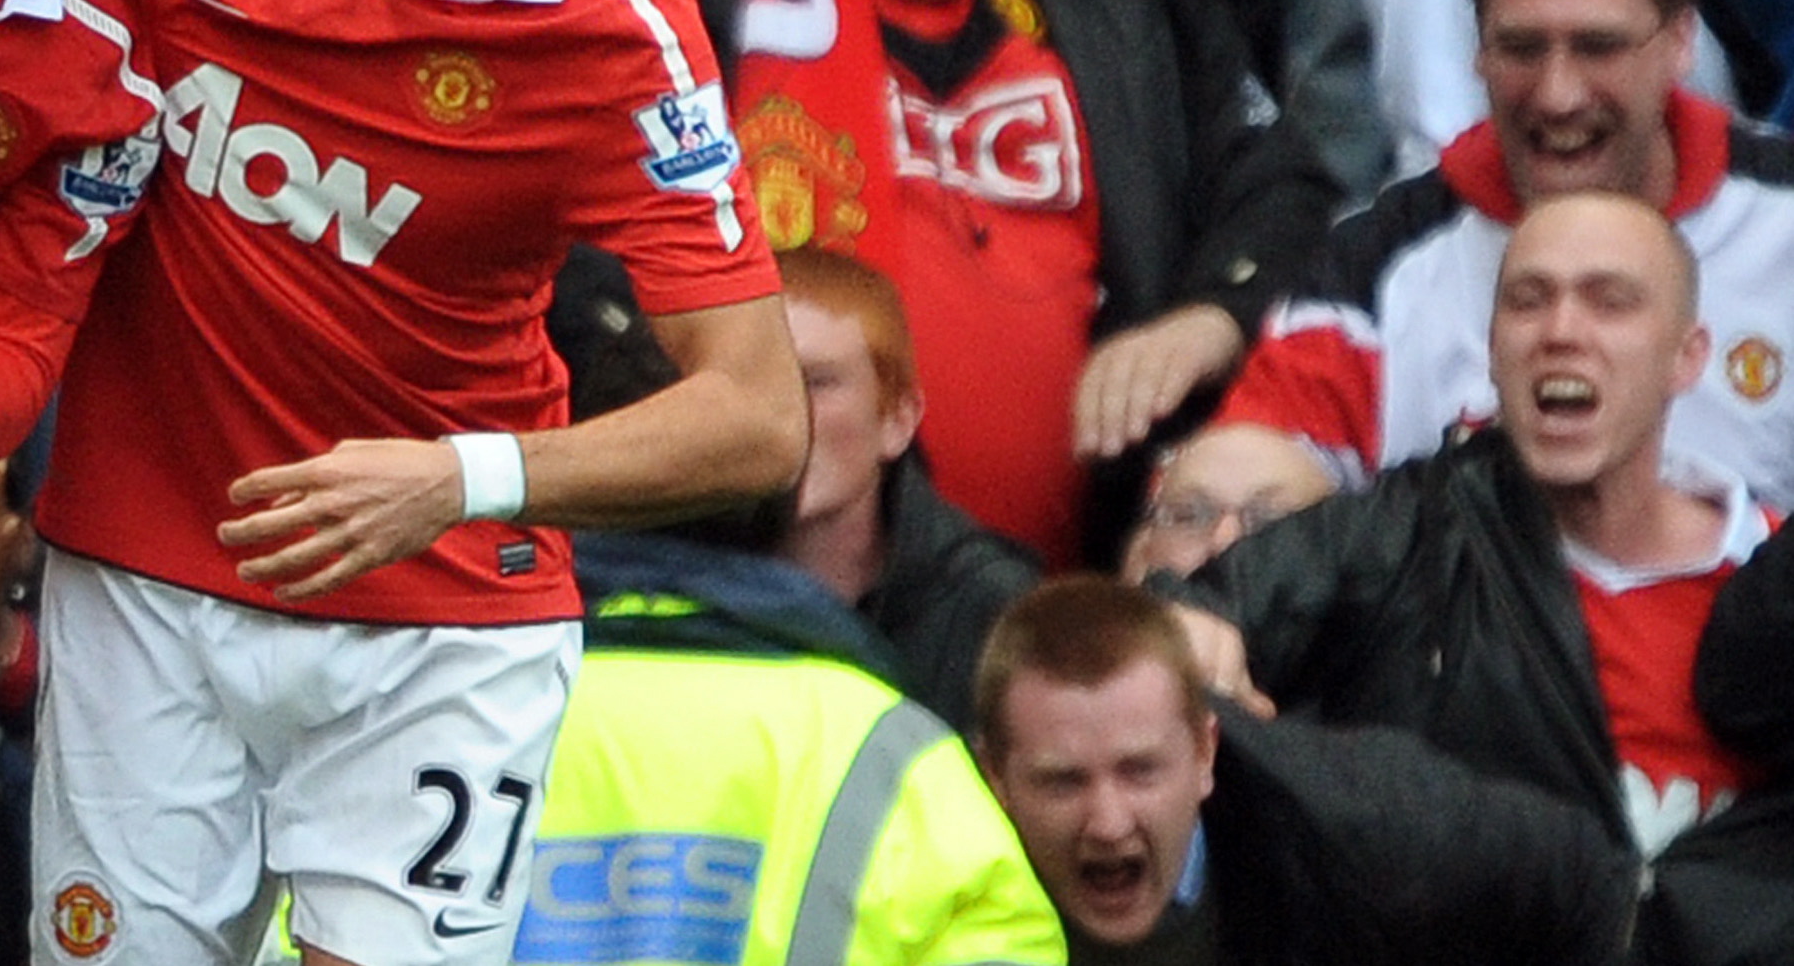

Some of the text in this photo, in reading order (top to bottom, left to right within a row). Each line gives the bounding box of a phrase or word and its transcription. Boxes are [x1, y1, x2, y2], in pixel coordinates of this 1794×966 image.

[163, 62, 423, 268] AON
[407, 766, 532, 904] 27
[530, 843, 753, 920] CES
